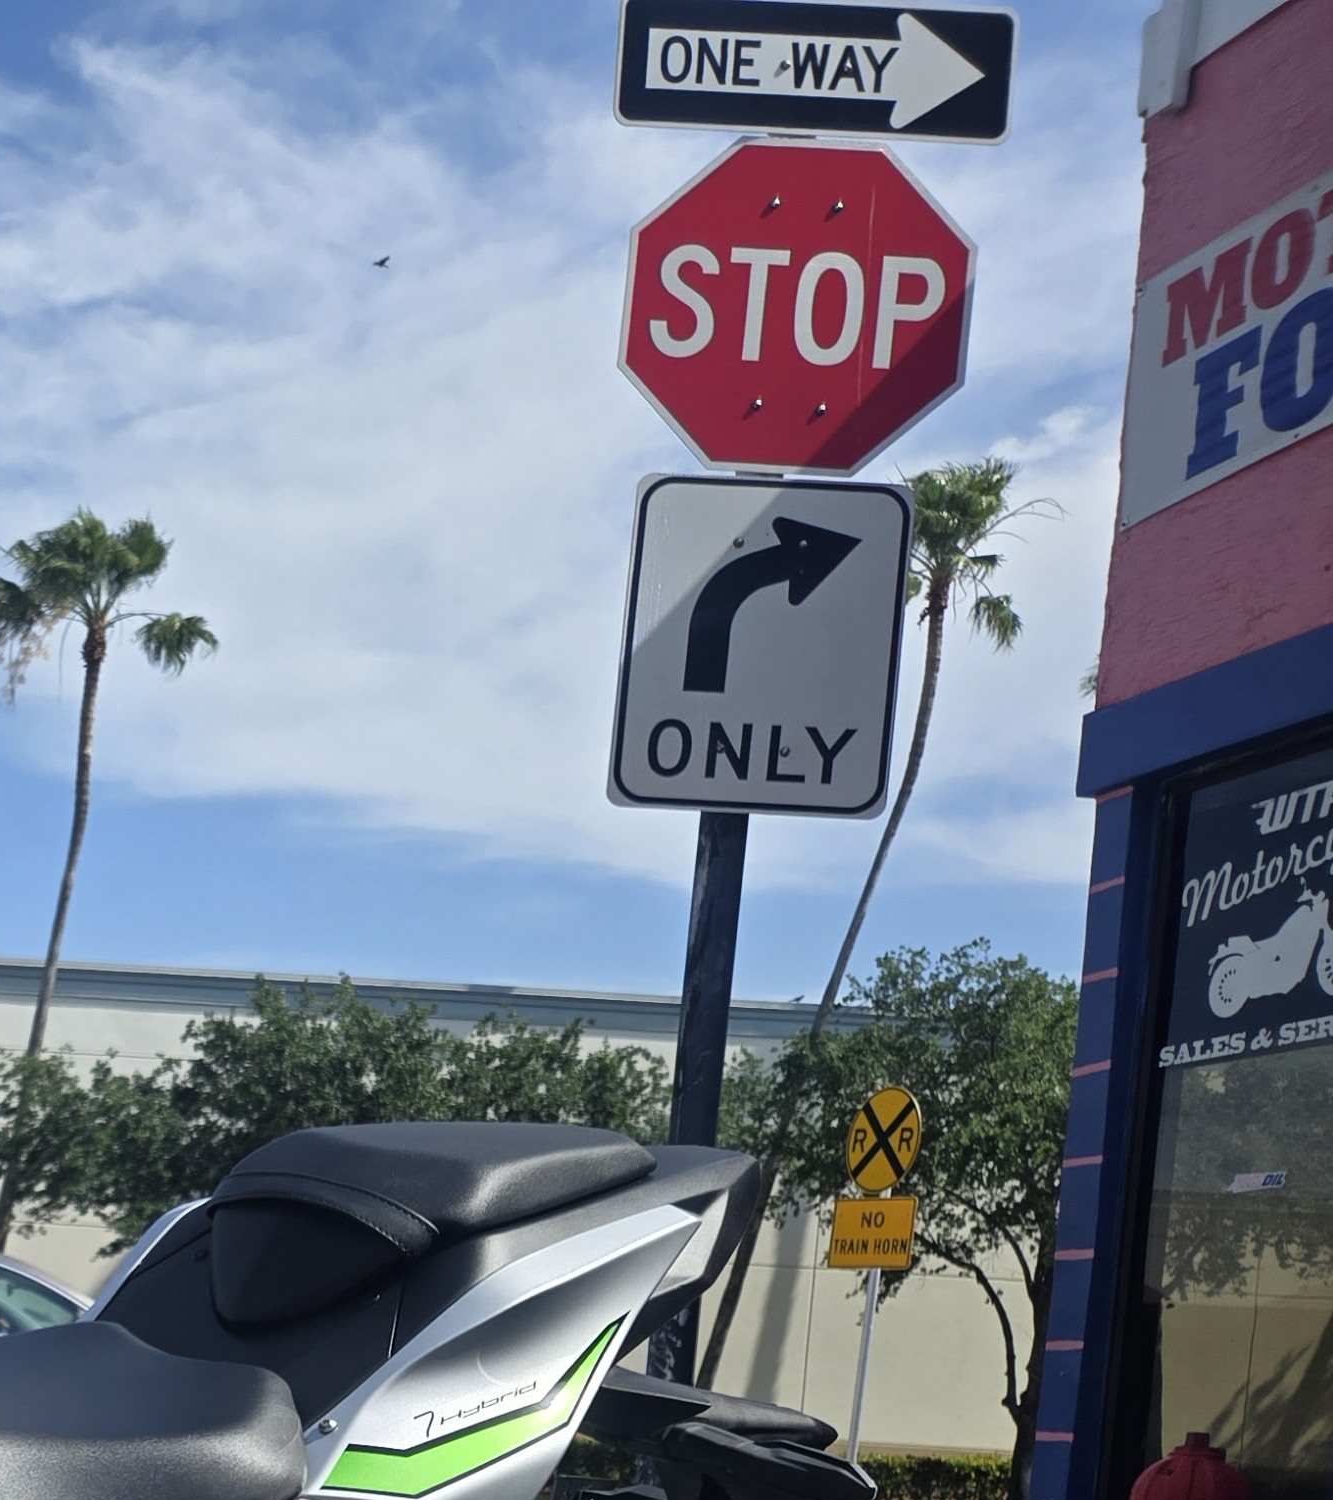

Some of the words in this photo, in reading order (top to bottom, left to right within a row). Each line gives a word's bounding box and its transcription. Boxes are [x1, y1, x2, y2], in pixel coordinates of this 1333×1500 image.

[659, 36, 762, 87] ONE
[790, 41, 900, 94] WAY
[649, 243, 946, 370] STOP
[647, 718, 858, 786] ONLY
[1158, 1031, 1246, 1068] SALES
[1250, 1028, 1273, 1051] &
[834, 1239, 869, 1255] TRAIN
[873, 1238, 908, 1255] HORN
[861, 1211, 885, 1229] NO
[414, 1410, 434, 1438] 7
[440, 1380, 537, 1425] Hybrid
